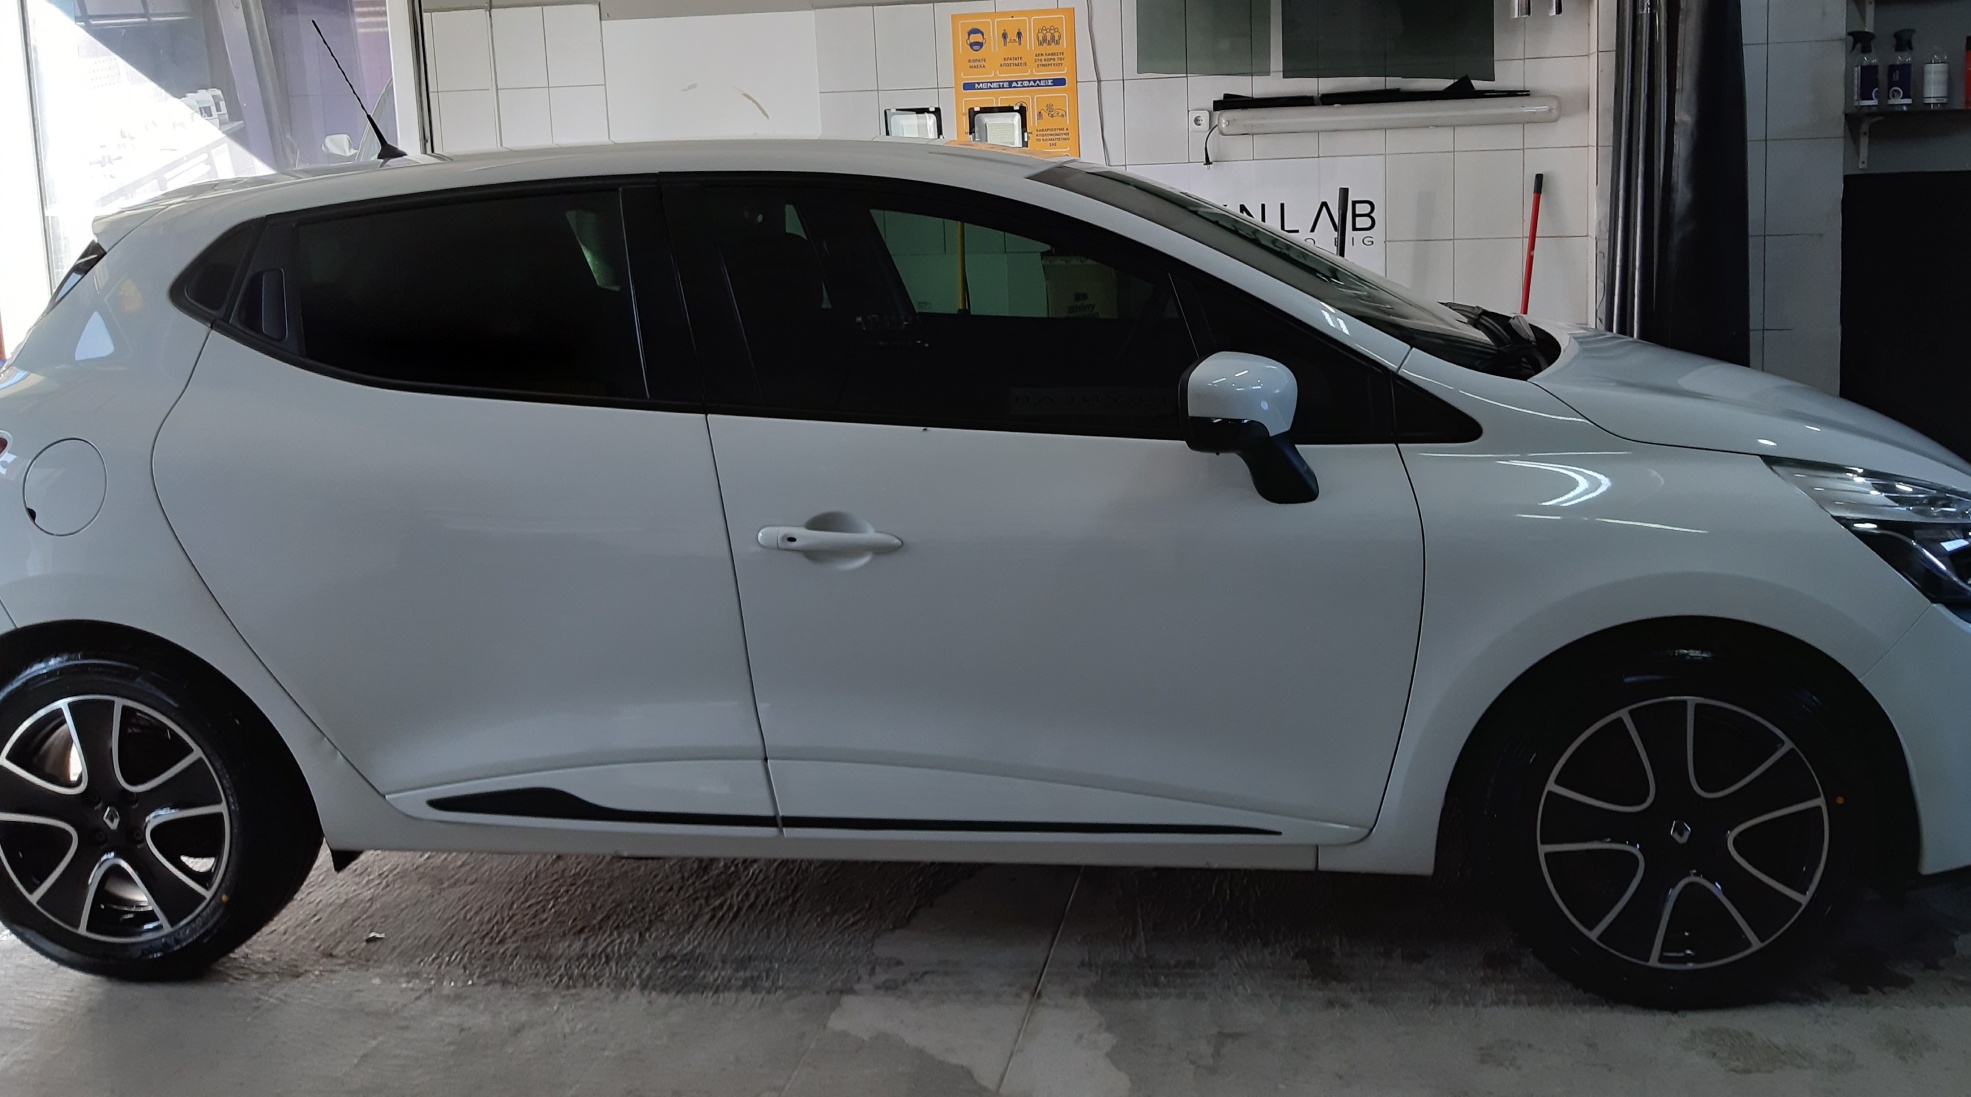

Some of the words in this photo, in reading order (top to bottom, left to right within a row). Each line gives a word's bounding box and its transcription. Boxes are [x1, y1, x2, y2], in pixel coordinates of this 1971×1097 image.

[974, 81, 1009, 89] ΜΕΝΕΤΕ
[1011, 79, 1054, 88] ΑΣΦΑΛΕΙΣ
[1223, 200, 1376, 233] NLAB
